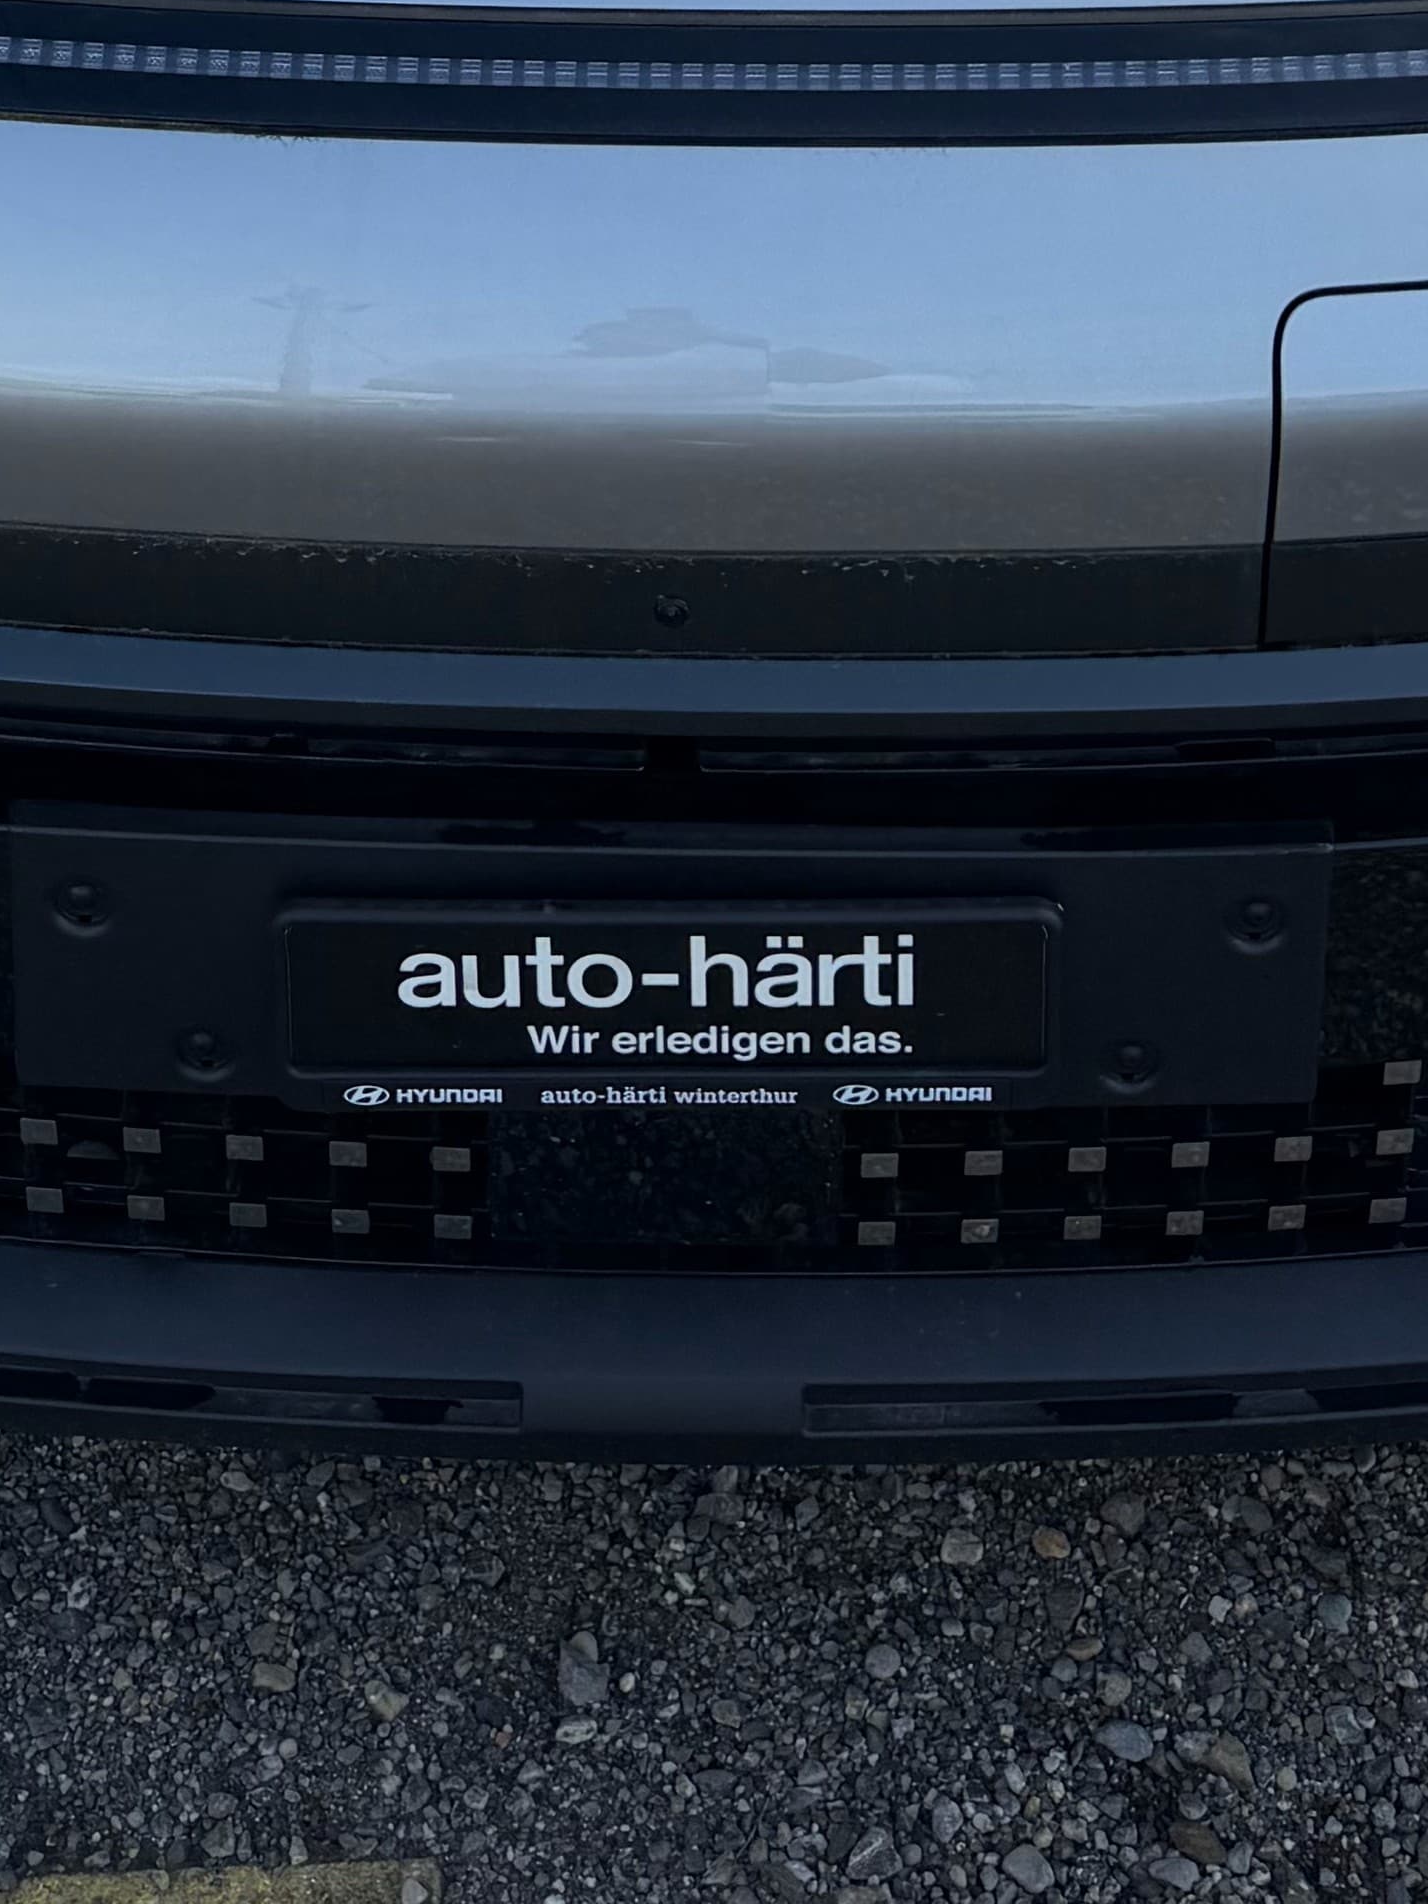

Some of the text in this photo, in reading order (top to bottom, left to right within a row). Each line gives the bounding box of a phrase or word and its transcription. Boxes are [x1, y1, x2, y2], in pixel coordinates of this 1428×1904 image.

[397, 934, 915, 1008] auto-härti
[526, 1025, 914, 1061] Wir erledigen das.
[395, 1088, 503, 1104] HYUNDAI
[540, 1085, 798, 1105] auto-härti winterthur
[885, 1087, 993, 1102] HYUNDAI
